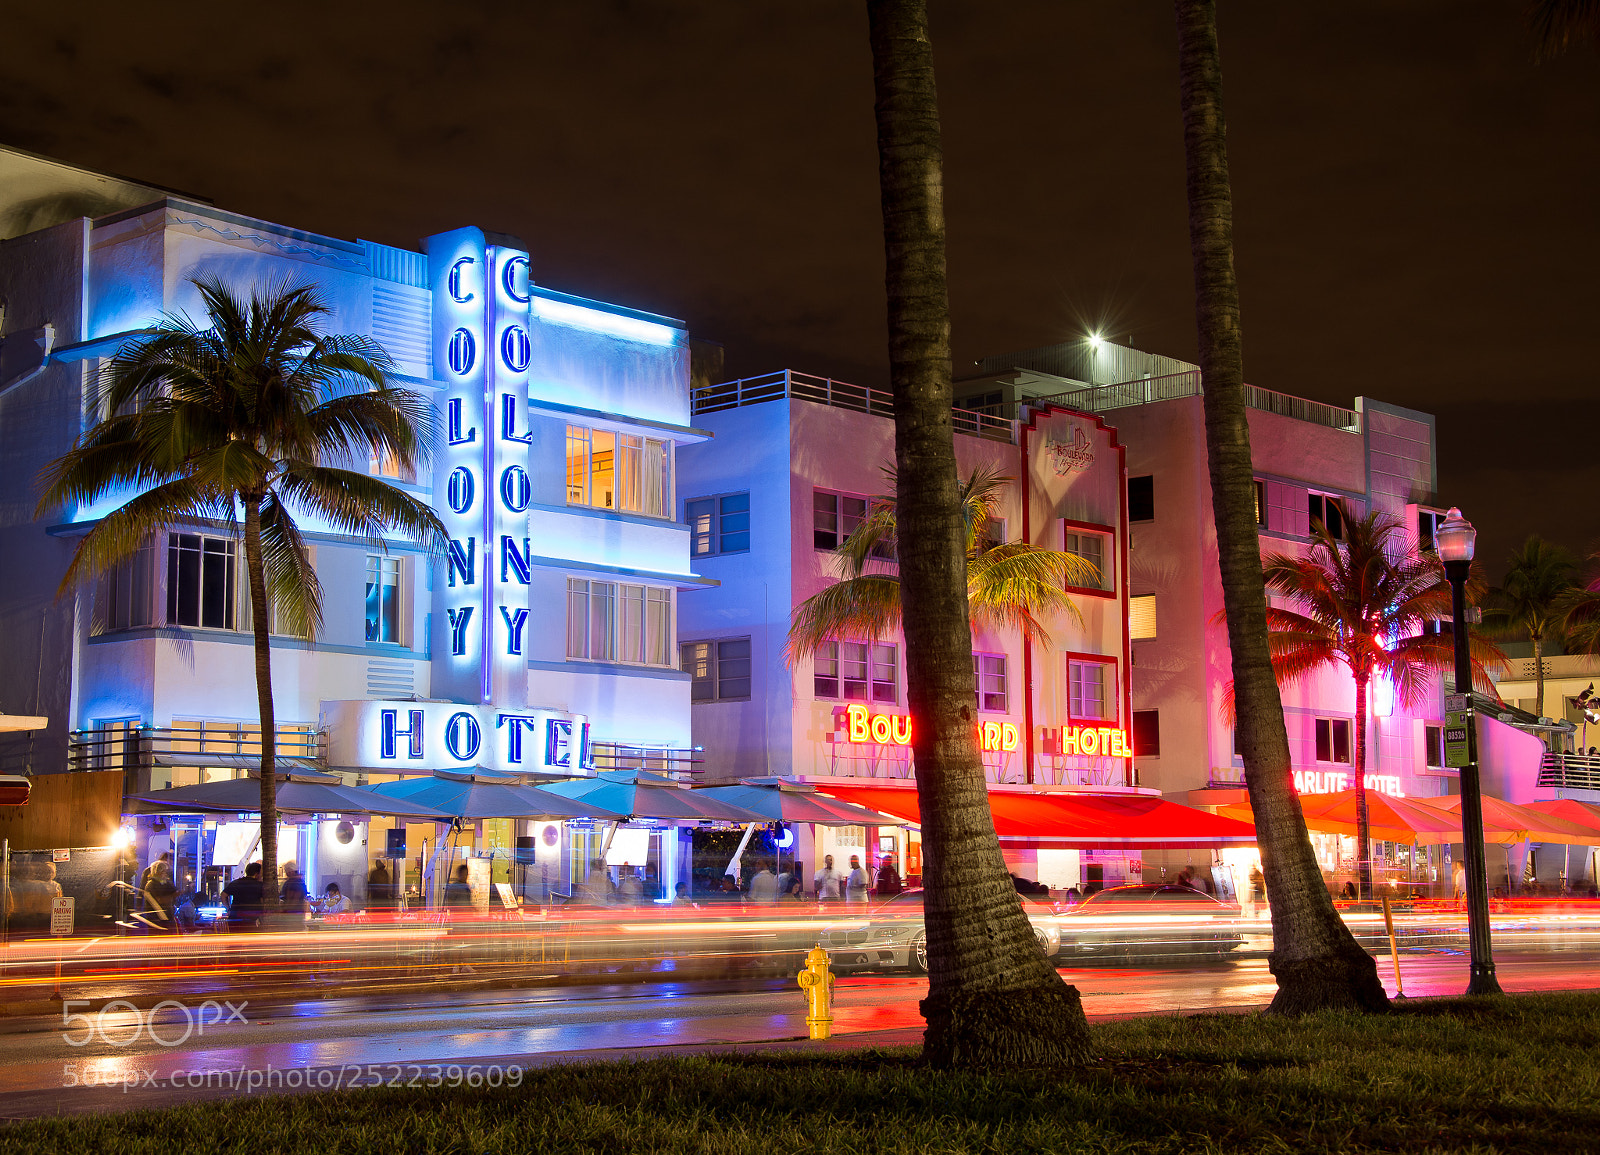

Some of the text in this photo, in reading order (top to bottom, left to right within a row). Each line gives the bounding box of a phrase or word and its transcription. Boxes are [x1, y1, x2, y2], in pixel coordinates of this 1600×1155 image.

[447, 255, 476, 656] COLONY
[499, 255, 533, 656] COLONY
[380, 708, 597, 771] HOTEL
[847, 704, 1132, 757] BOURD HOTEL
[1291, 770, 1347, 794] ARLITE
[54, 907, 71, 915] PARKING
